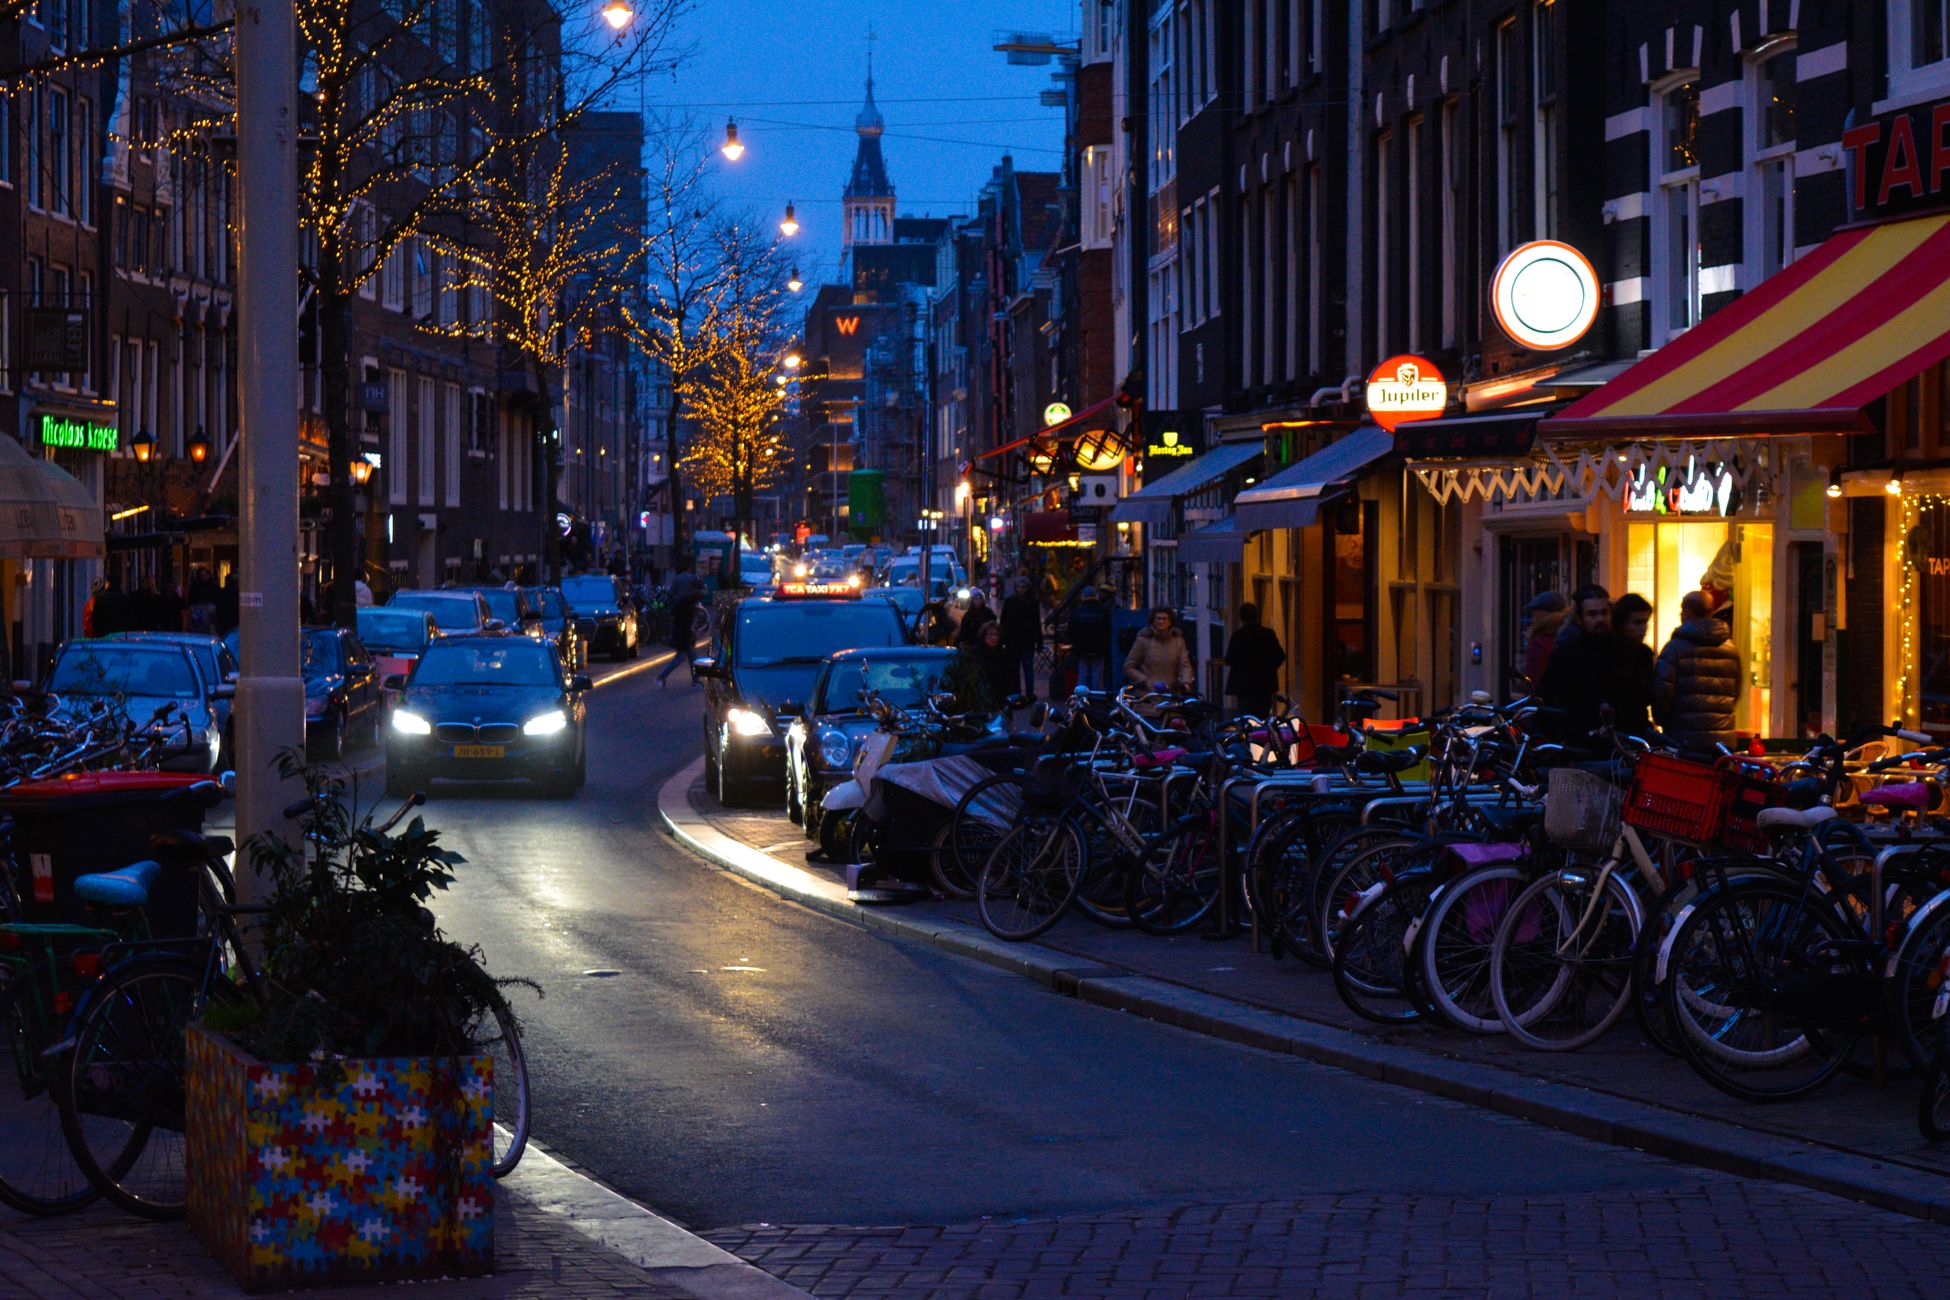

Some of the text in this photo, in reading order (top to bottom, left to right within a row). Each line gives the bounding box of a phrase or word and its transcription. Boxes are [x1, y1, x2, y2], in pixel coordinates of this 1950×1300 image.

[835, 316, 860, 336] W
[1379, 388, 1440, 405] Jupiler
[1149, 445, 1193, 456] Hertog Jan
[784, 585, 805, 594] TCA
[805, 584, 828, 594] TAXI
